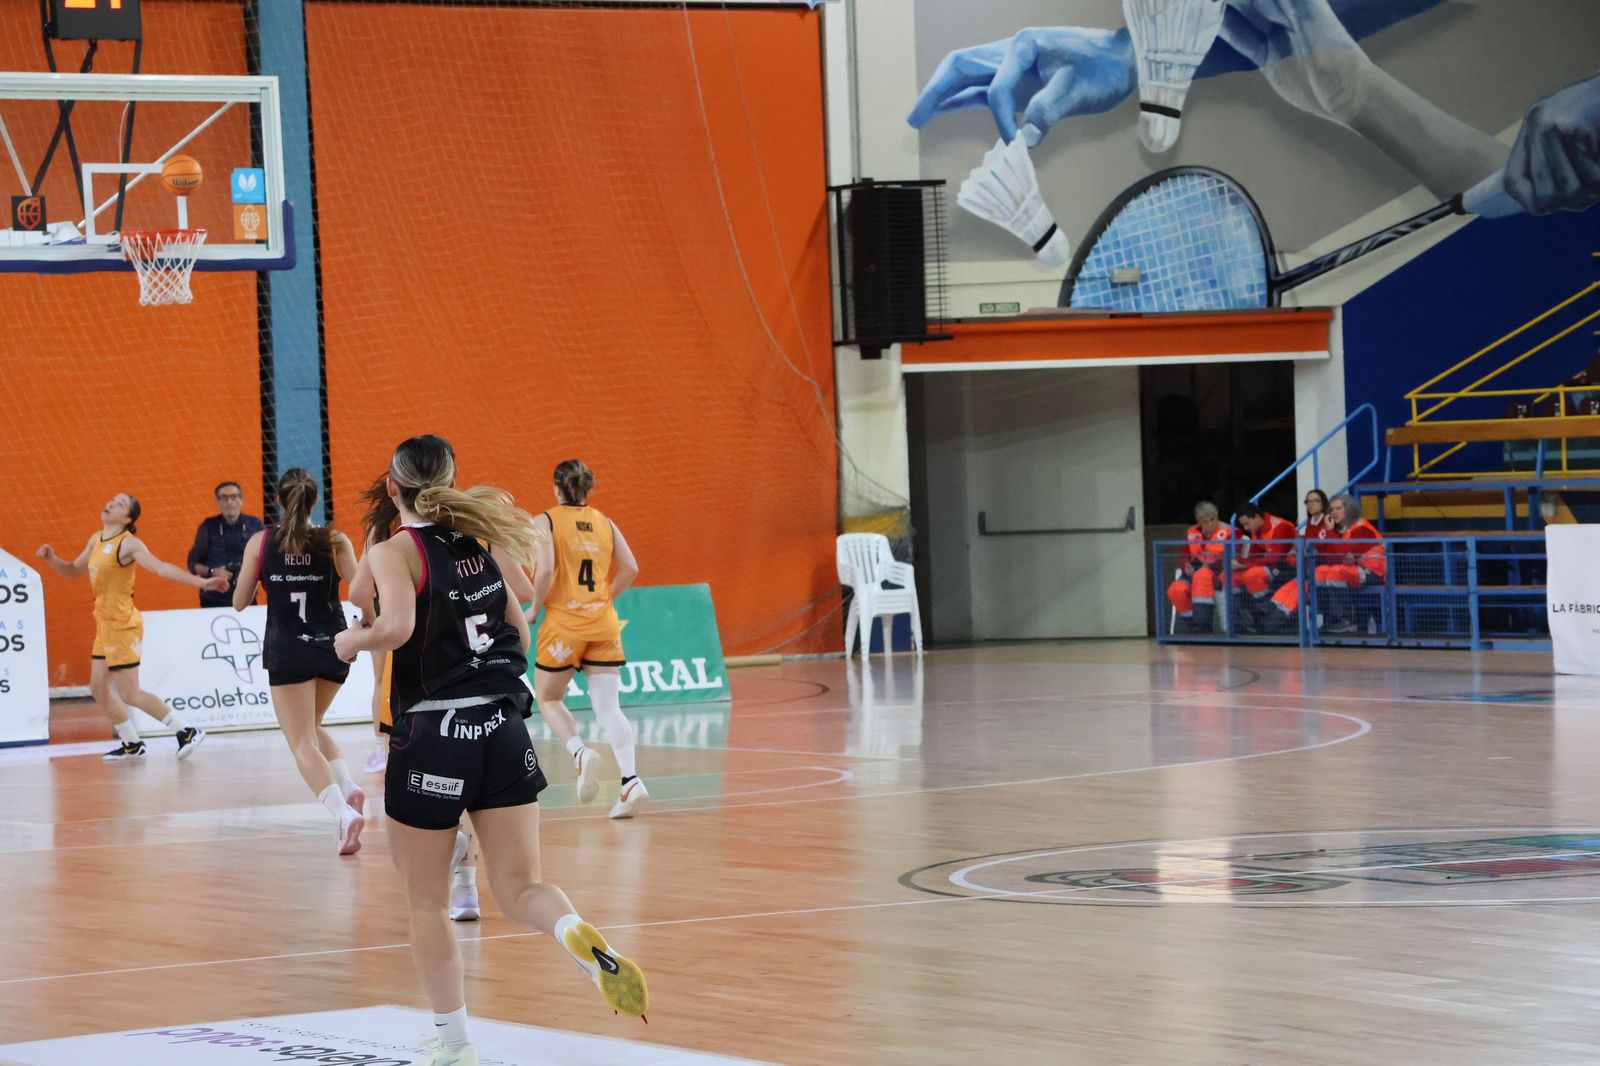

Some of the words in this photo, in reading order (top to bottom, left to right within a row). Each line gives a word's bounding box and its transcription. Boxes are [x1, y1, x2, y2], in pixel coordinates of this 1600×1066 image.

[284, 553, 311, 566] RECIO
[578, 558, 595, 592] 4
[290, 591, 307, 623] 7
[1552, 603, 1566, 613] LA
[464, 612, 495, 654] 5
[618, 658, 723, 693] URAL
[410, 773, 422, 786] E
[426, 780, 460, 792] essiif
